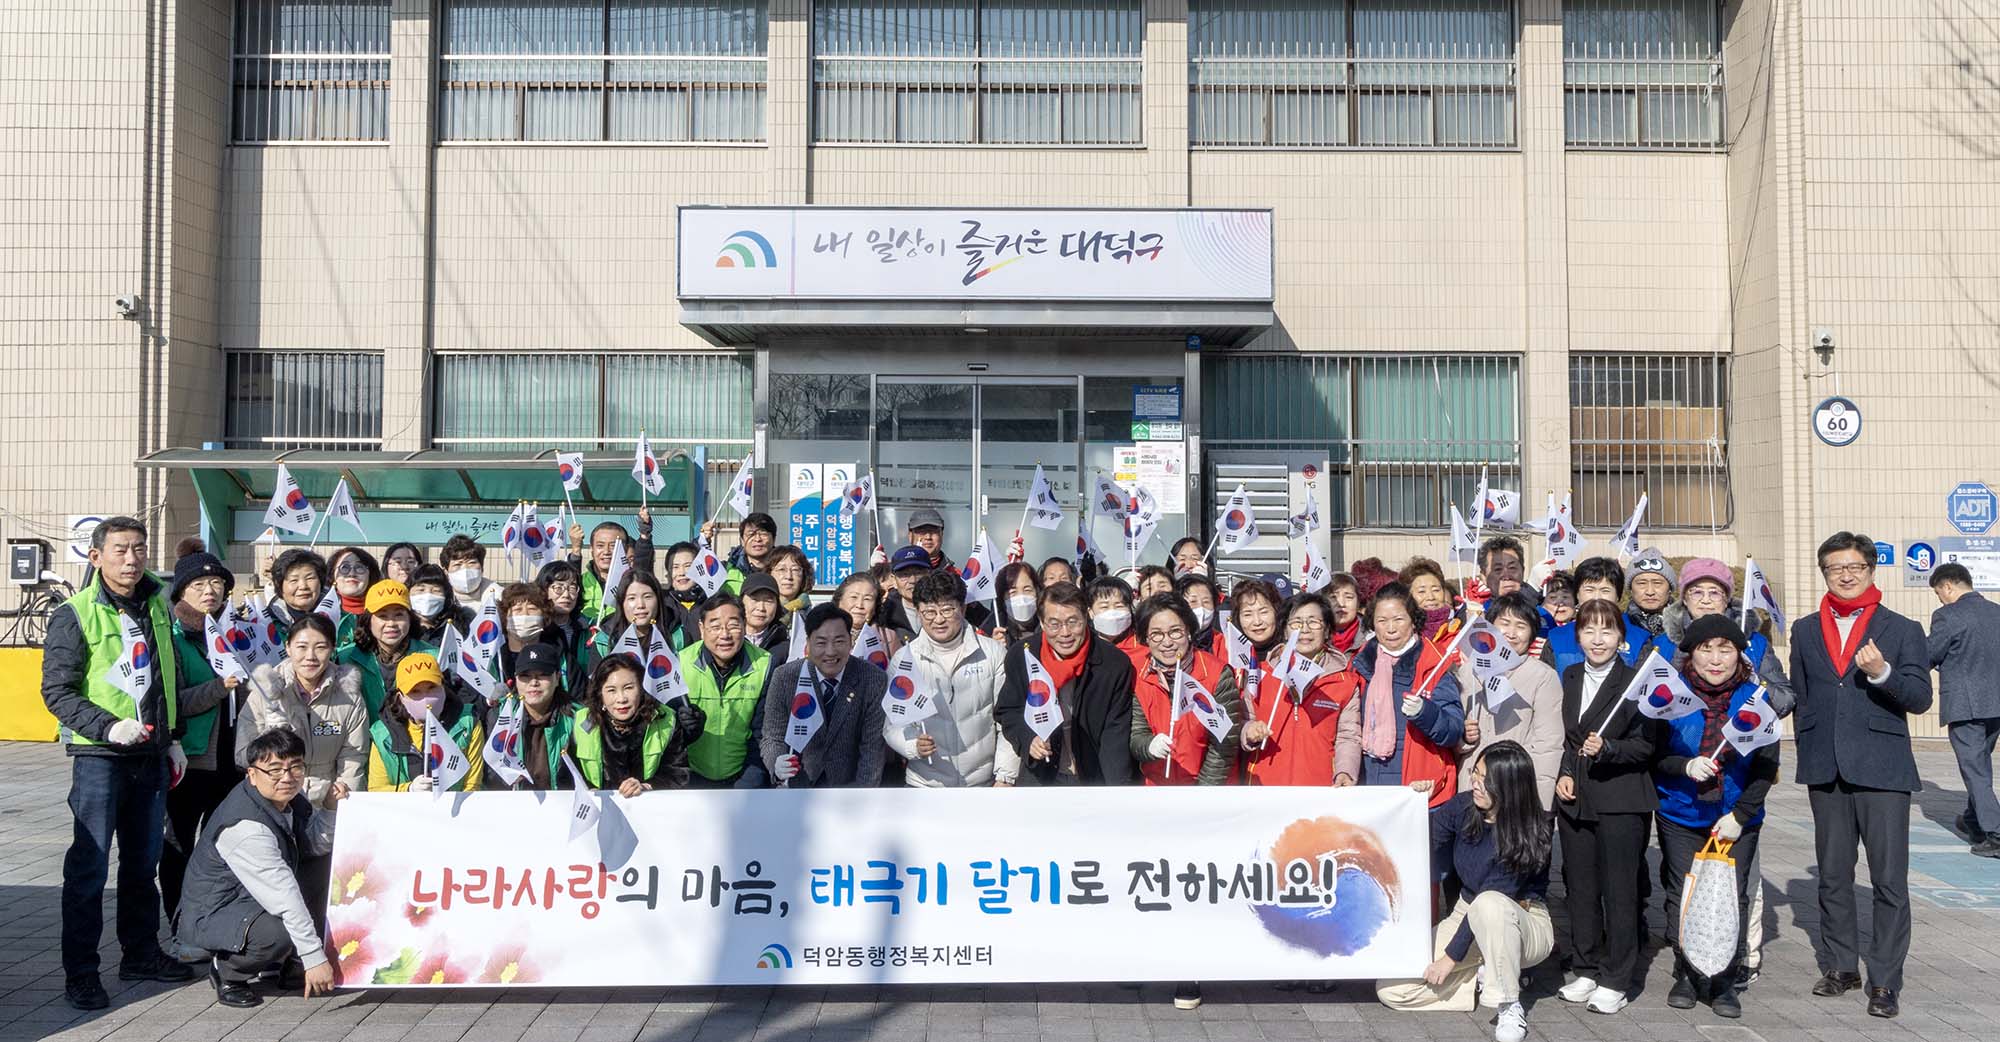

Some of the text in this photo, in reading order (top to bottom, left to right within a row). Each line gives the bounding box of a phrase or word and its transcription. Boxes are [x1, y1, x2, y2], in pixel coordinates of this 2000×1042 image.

[813, 219, 1165, 286] 내 일상이 즐거운 대덕구
[1827, 417, 1848, 431] 60
[1956, 498, 1990, 518] ADT
[425, 520, 438, 532] 내
[412, 857, 1338, 920] 나라사랑의 마음, 태극기 달기로 전하세요!
[803, 943, 994, 968] 덕암동행정복지센터
